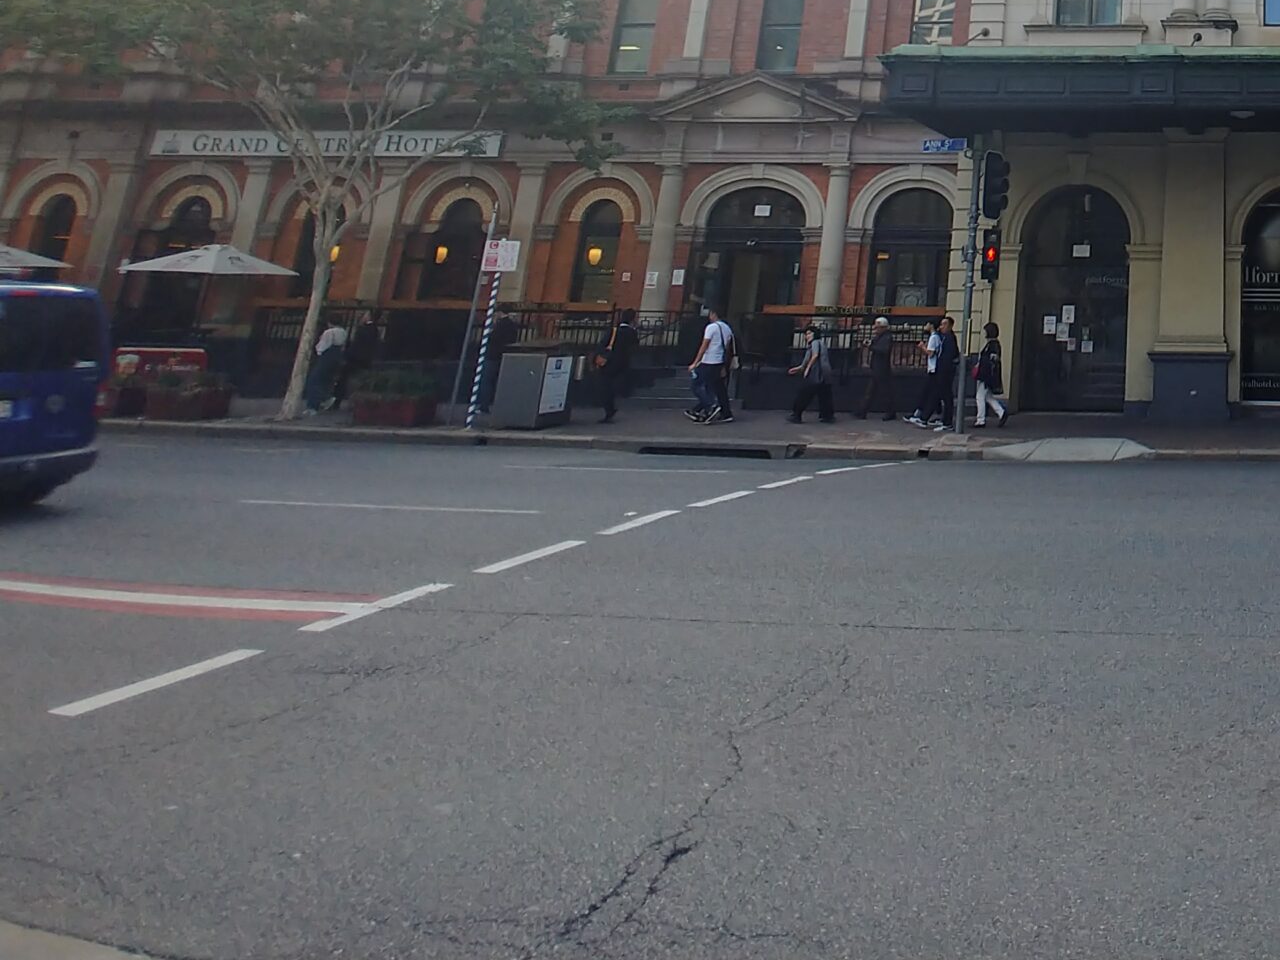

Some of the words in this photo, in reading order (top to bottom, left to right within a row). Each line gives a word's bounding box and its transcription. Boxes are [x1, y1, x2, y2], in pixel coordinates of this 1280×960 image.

[193, 134, 268, 153] GRAND
[384, 134, 452, 153] HOTE
[925, 139, 941, 147] ANN
